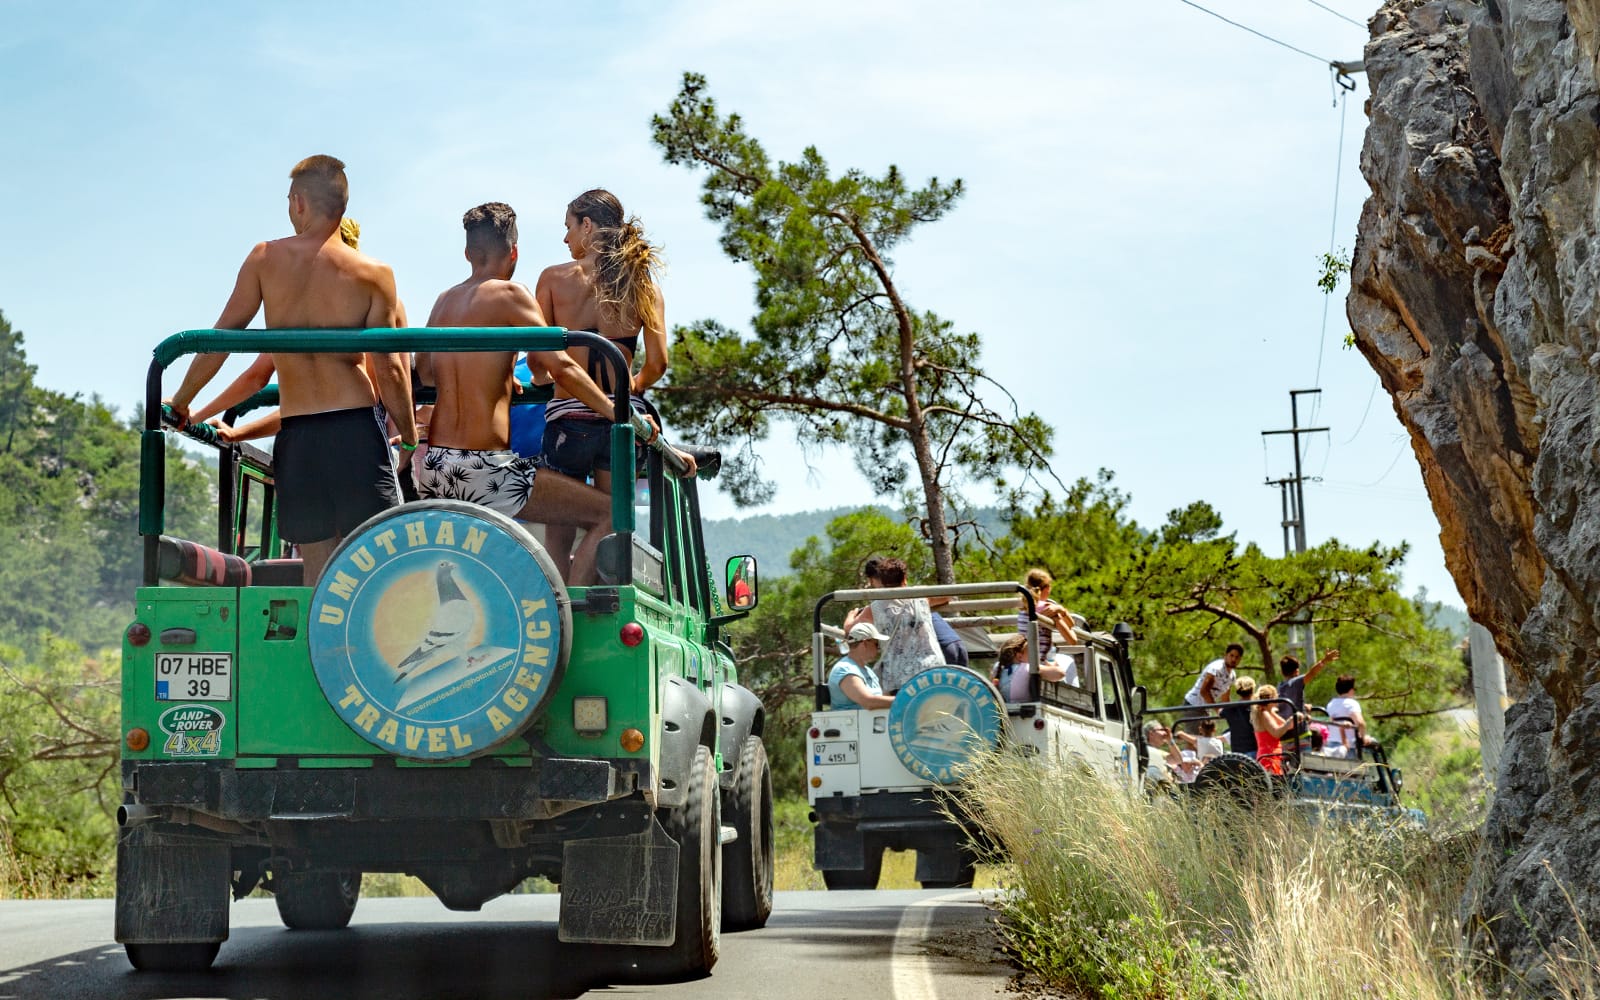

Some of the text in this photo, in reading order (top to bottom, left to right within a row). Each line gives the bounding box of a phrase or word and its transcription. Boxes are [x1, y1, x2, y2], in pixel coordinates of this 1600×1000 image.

[319, 520, 488, 625] UMUTHAN
[160, 657, 228, 676] 07 HBE
[338, 598, 551, 752] TRAVEL AGENCY
[187, 679, 210, 697] 39
[905, 672, 990, 708] UMUTHAN
[815, 743, 856, 753] 07 N
[828, 753, 846, 762] 4151
